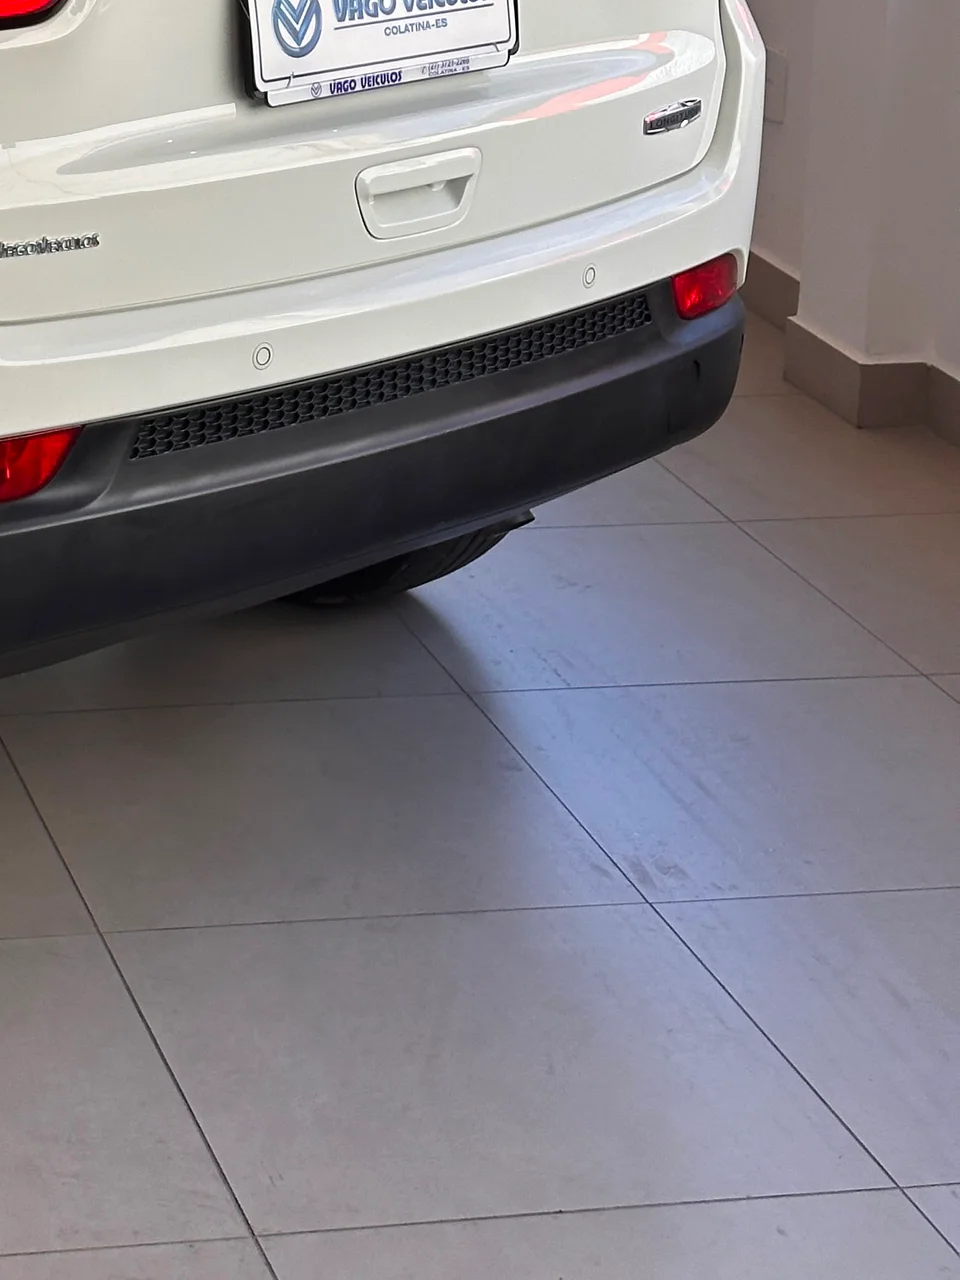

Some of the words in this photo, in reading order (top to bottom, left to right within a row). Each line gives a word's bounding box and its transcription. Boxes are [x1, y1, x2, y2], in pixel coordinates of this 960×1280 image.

[384, 17, 448, 37] COLATINA-ES
[329, 78, 357, 95] VAGO
[360, 69, 403, 89] VEICULOS
